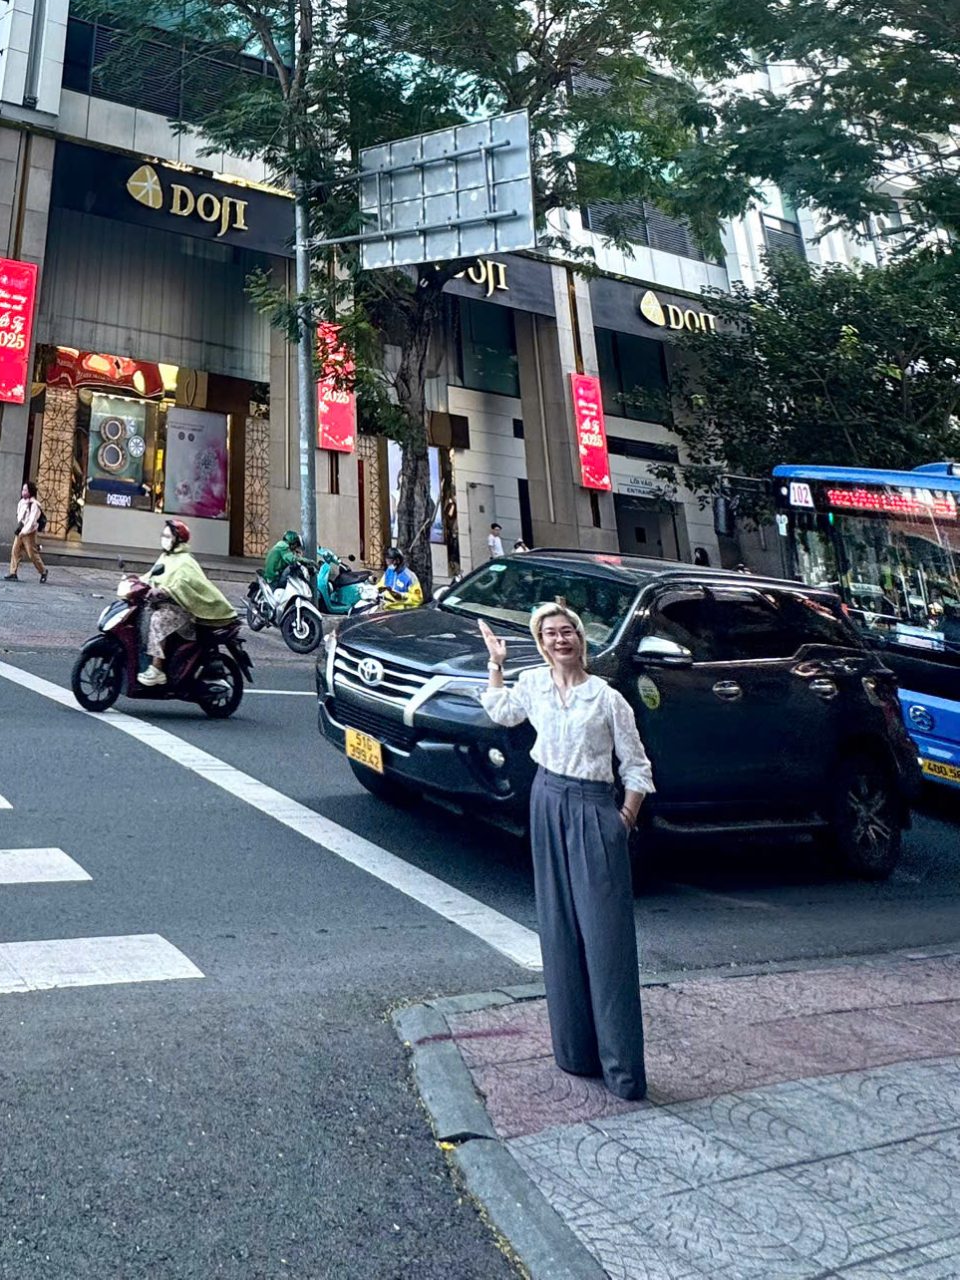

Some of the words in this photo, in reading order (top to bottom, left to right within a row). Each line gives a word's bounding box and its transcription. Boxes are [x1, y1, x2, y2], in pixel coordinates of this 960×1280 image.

[169, 183, 249, 237] DOJI
[453, 258, 510, 297] OJI
[792, 485, 810, 504] 102
